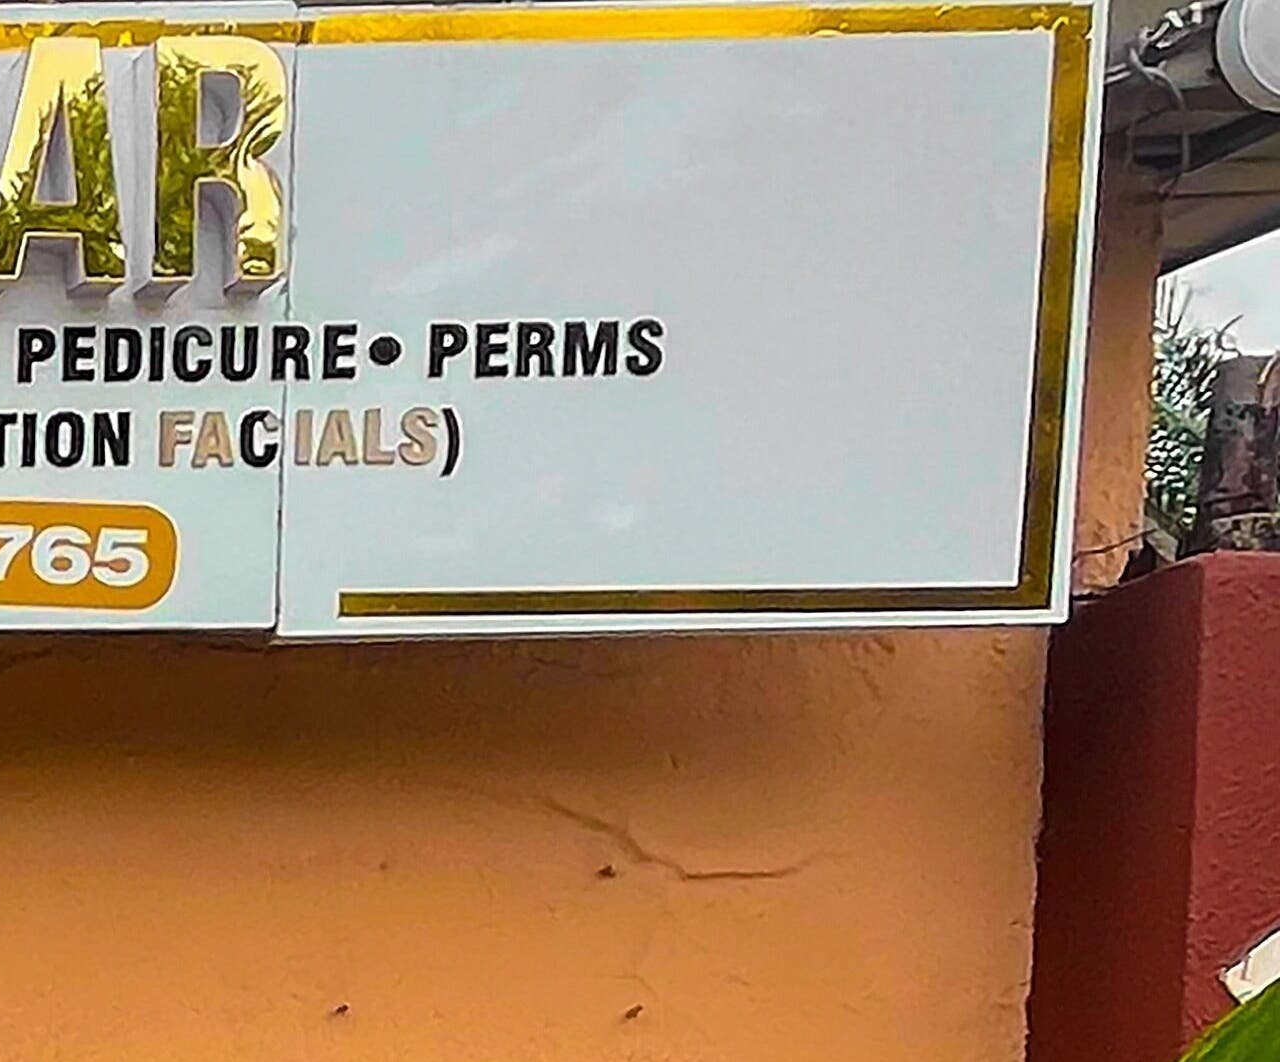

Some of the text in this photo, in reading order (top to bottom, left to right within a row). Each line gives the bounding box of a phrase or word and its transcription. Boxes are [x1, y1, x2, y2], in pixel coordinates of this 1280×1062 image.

[16, 323, 358, 383] PEDICURE
[427, 320, 665, 379] PERMS
[157, 406, 462, 477] FACIALS)
